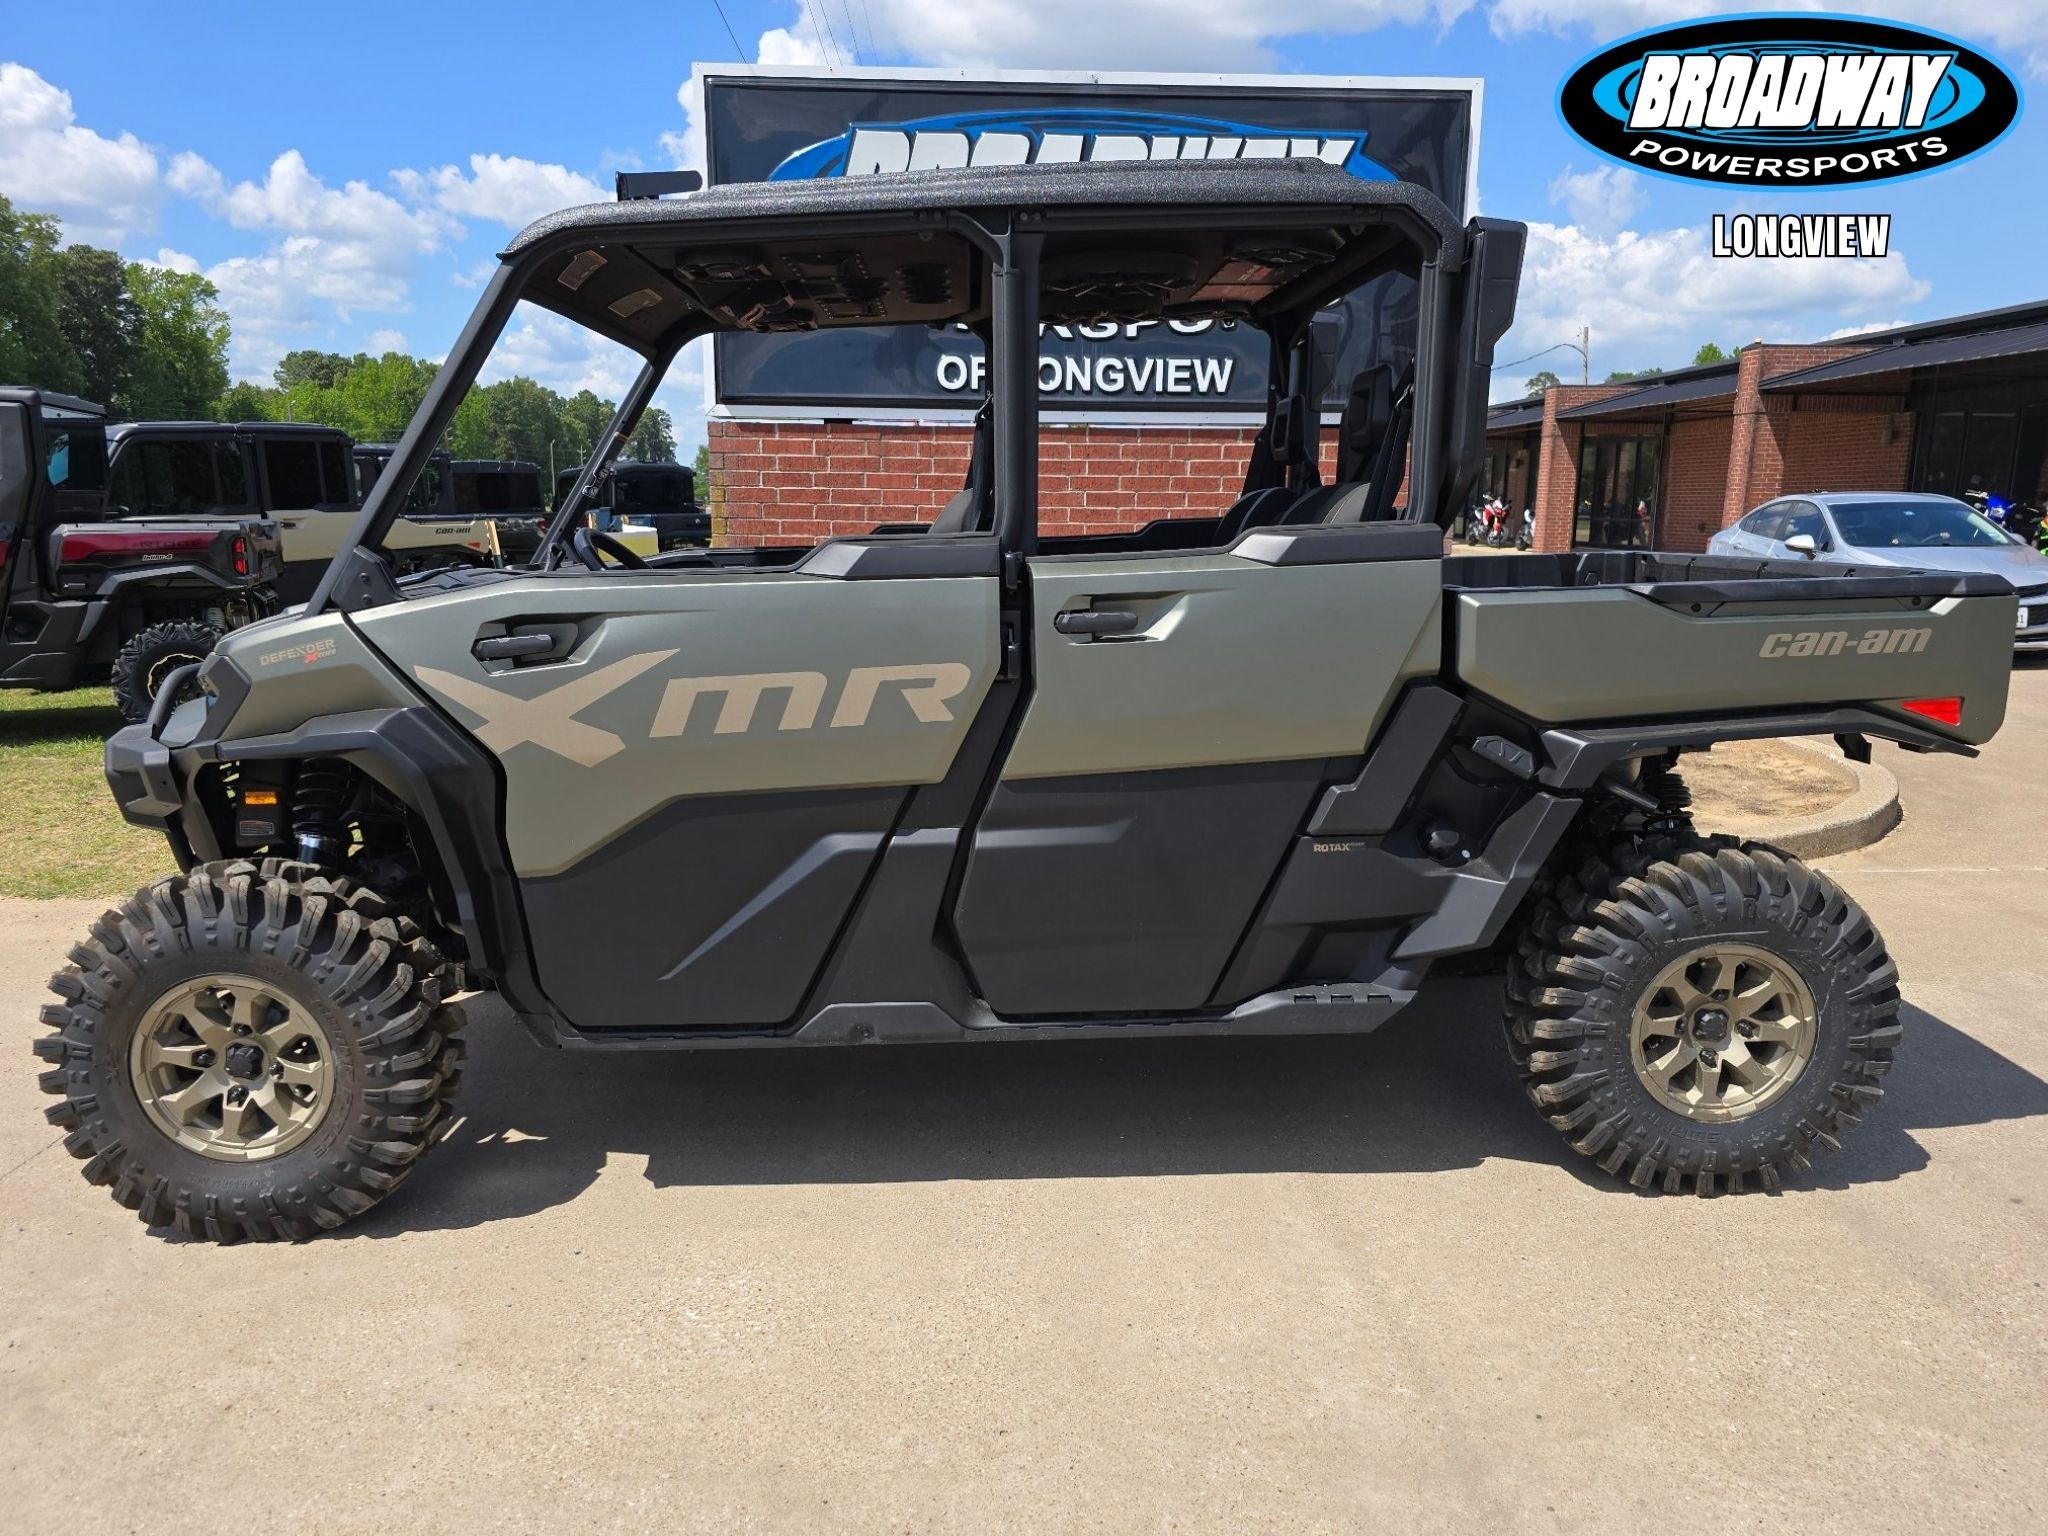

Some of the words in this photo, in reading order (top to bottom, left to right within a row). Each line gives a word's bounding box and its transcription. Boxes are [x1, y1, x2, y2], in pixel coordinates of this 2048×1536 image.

[1038, 355, 1233, 393] ONGVIEW
[260, 639, 336, 666] DEFENDER
[1759, 627, 1932, 658] can-am
[1313, 843, 1350, 852] ROTAX
